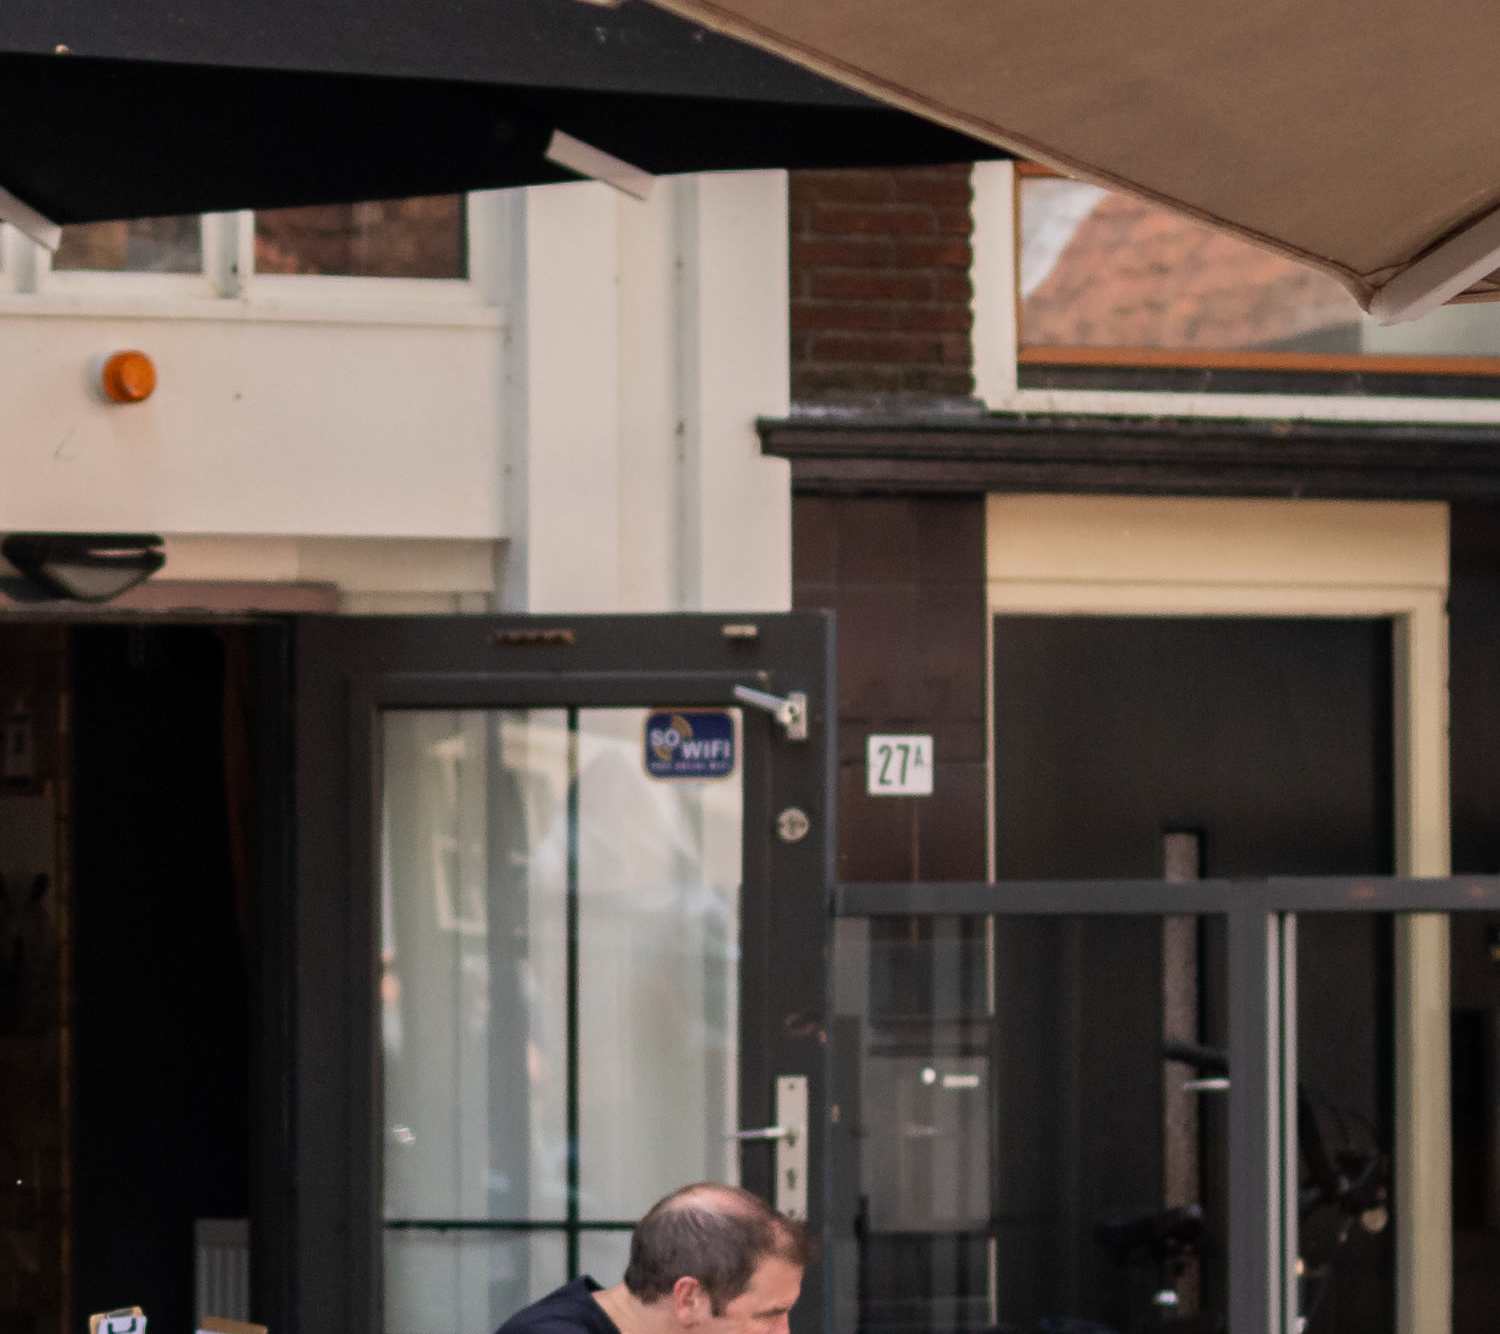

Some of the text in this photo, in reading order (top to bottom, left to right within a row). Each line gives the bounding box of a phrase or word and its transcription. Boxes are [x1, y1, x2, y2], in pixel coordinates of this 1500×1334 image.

[650, 727, 731, 760] SO WIFI
[876, 743, 926, 787] 27A
